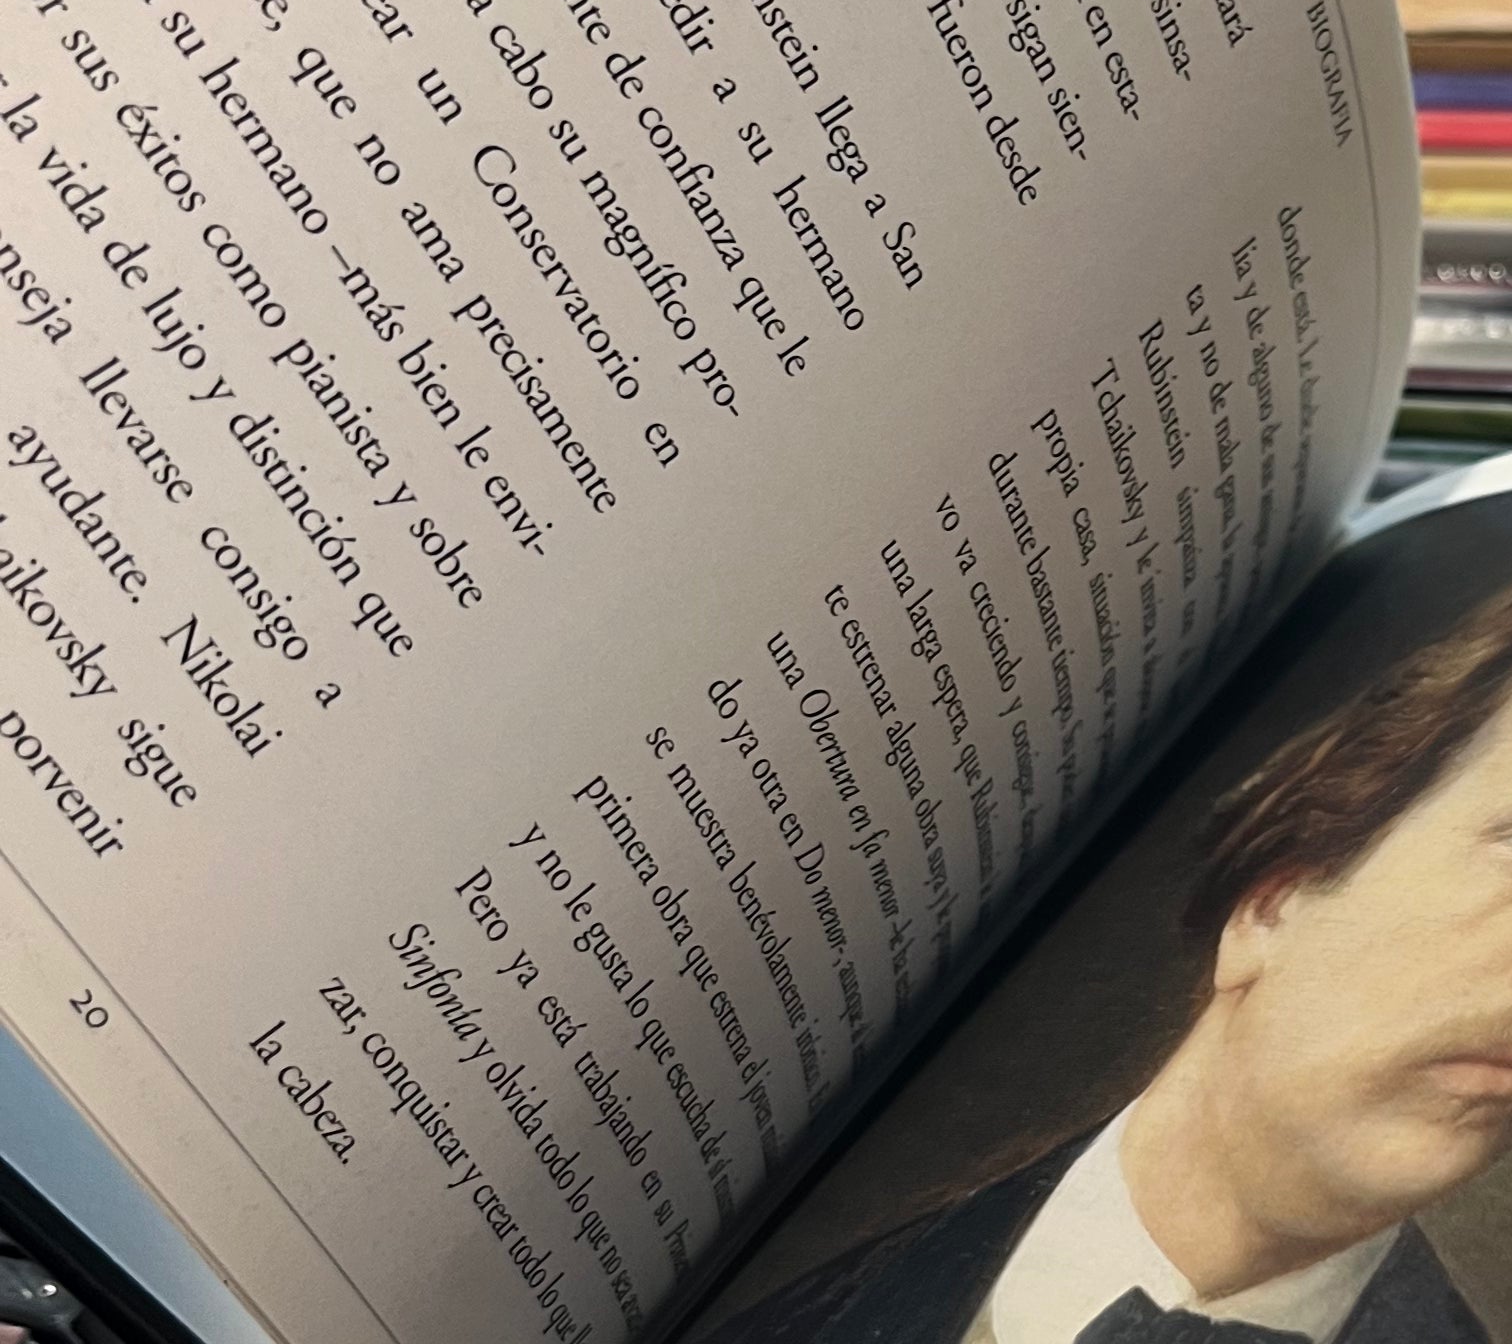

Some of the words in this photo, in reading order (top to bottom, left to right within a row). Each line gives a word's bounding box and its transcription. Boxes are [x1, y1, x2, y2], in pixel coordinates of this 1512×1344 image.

[1084, 5, 1113, 50] en
[1104, 51, 1140, 121] esta-
[1047, 87, 1087, 161] sien-
[985, 115, 1042, 207] desde
[489, 24, 554, 110] cabo
[548, 119, 588, 166] su
[579, 169, 697, 341] magnífico
[677, 347, 739, 417] pro-
[604, 52, 647, 100] de
[637, 106, 745, 273] confianza
[731, 276, 786, 341] que
[776, 335, 810, 378] le
[712, 77, 737, 105] a
[737, 121, 774, 166] su
[771, 173, 865, 331] hermano
[814, 94, 869, 186] llega
[863, 193, 887, 220] a
[881, 221, 924, 292] San
[1137, 316, 1191, 470] Rubinstein
[1090, 356, 1149, 525] Tchaikovsky
[1029, 408, 1085, 499] propia
[1072, 507, 1097, 568] casa,
[1125, 525, 1149, 548] y
[1136, 541, 1161, 575] le
[7, 424, 148, 605] ayudante.
[159, 612, 283, 760] Nikolai
[766, 629, 806, 692] una
[707, 677, 744, 720] do
[719, 718, 760, 760] ya
[799, 688, 861, 803] Obertura
[0, 709, 124, 859] porvenir
[751, 758, 788, 815] otra
[778, 812, 804, 850] en
[847, 804, 872, 833] en
[848, 828, 891, 860] fa
[644, 726, 675, 760] se
[666, 762, 737, 873] muestra
[727, 860, 807, 1030] benévolamente
[792, 840, 826, 886] Do
[868, 857, 900, 920] menor
[570, 774, 660, 888] primera
[651, 885, 694, 948] obra
[677, 944, 719, 993] que
[709, 990, 752, 1067] estrena
[68, 988, 110, 1029] 20
[318, 976, 367, 1036] zar,
[388, 923, 484, 1042] Sinfonía
[454, 864, 509, 942] Pero
[494, 947, 540, 991] ya
[537, 995, 589, 1050] está
[573, 1050, 654, 1168] trabajando
[640, 1169, 663, 1202] en
[652, 1198, 675, 1228] su
[457, 1036, 497, 1064] y
[248, 1019, 287, 1067] la
[277, 1065, 356, 1167] cabeza.
[361, 1032, 470, 1170] conquistar
[485, 1061, 549, 1141] olvida
[446, 1161, 484, 1190] y
[533, 1132, 581, 1191] todo
[472, 1184, 520, 1243] crear
[563, 1175, 595, 1214] lo
[507, 1234, 553, 1289] todo
[572, 1209, 612, 1252] que
[597, 1244, 623, 1276] no
[535, 1271, 566, 1310] lo
[541, 1303, 578, 1343] que
